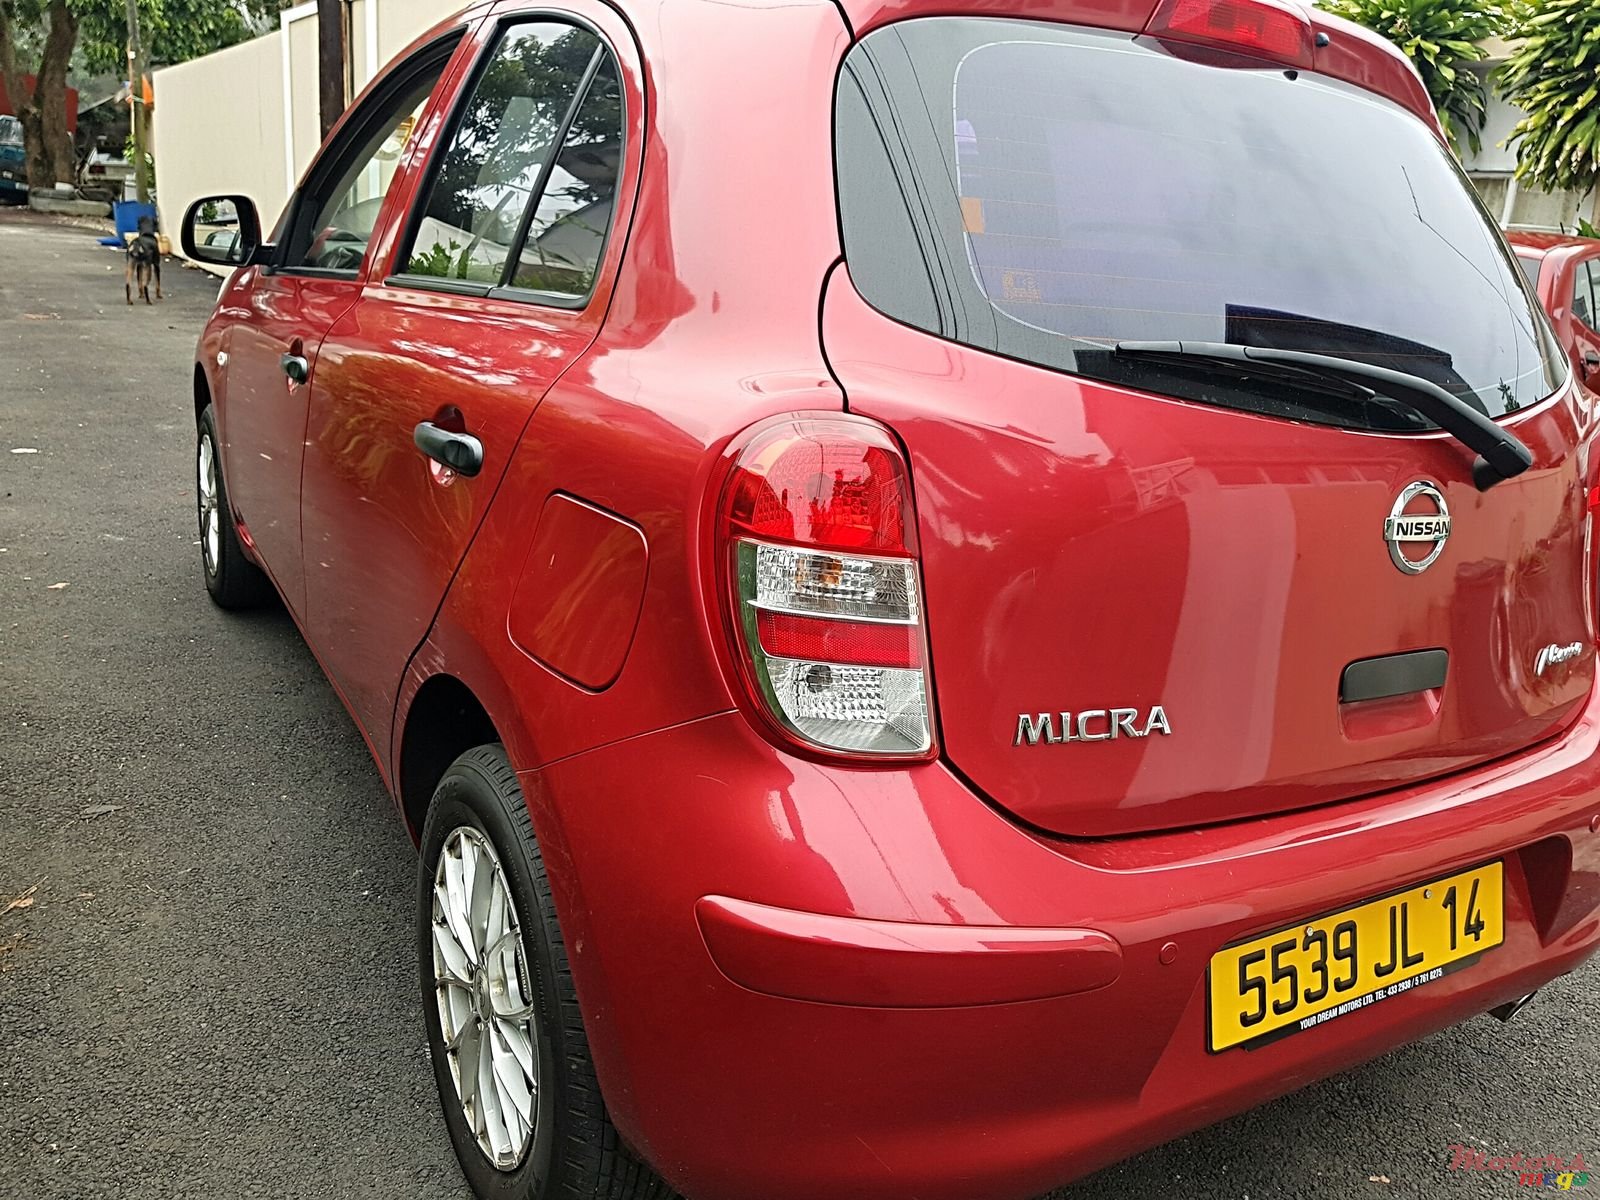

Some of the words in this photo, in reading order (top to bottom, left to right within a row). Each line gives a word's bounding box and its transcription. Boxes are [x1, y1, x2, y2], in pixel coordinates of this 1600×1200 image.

[1396, 521, 1450, 536] NISSAN
[1014, 705, 1172, 746] MICRA
[1239, 920, 1358, 1028] 5539
[1374, 902, 1425, 978] JL
[1441, 878, 1485, 950] 14
[1299, 1015, 1317, 1030] YOUR
[1317, 1007, 1338, 1024] DREAM
[1338, 997, 1363, 1015] MOTORS
